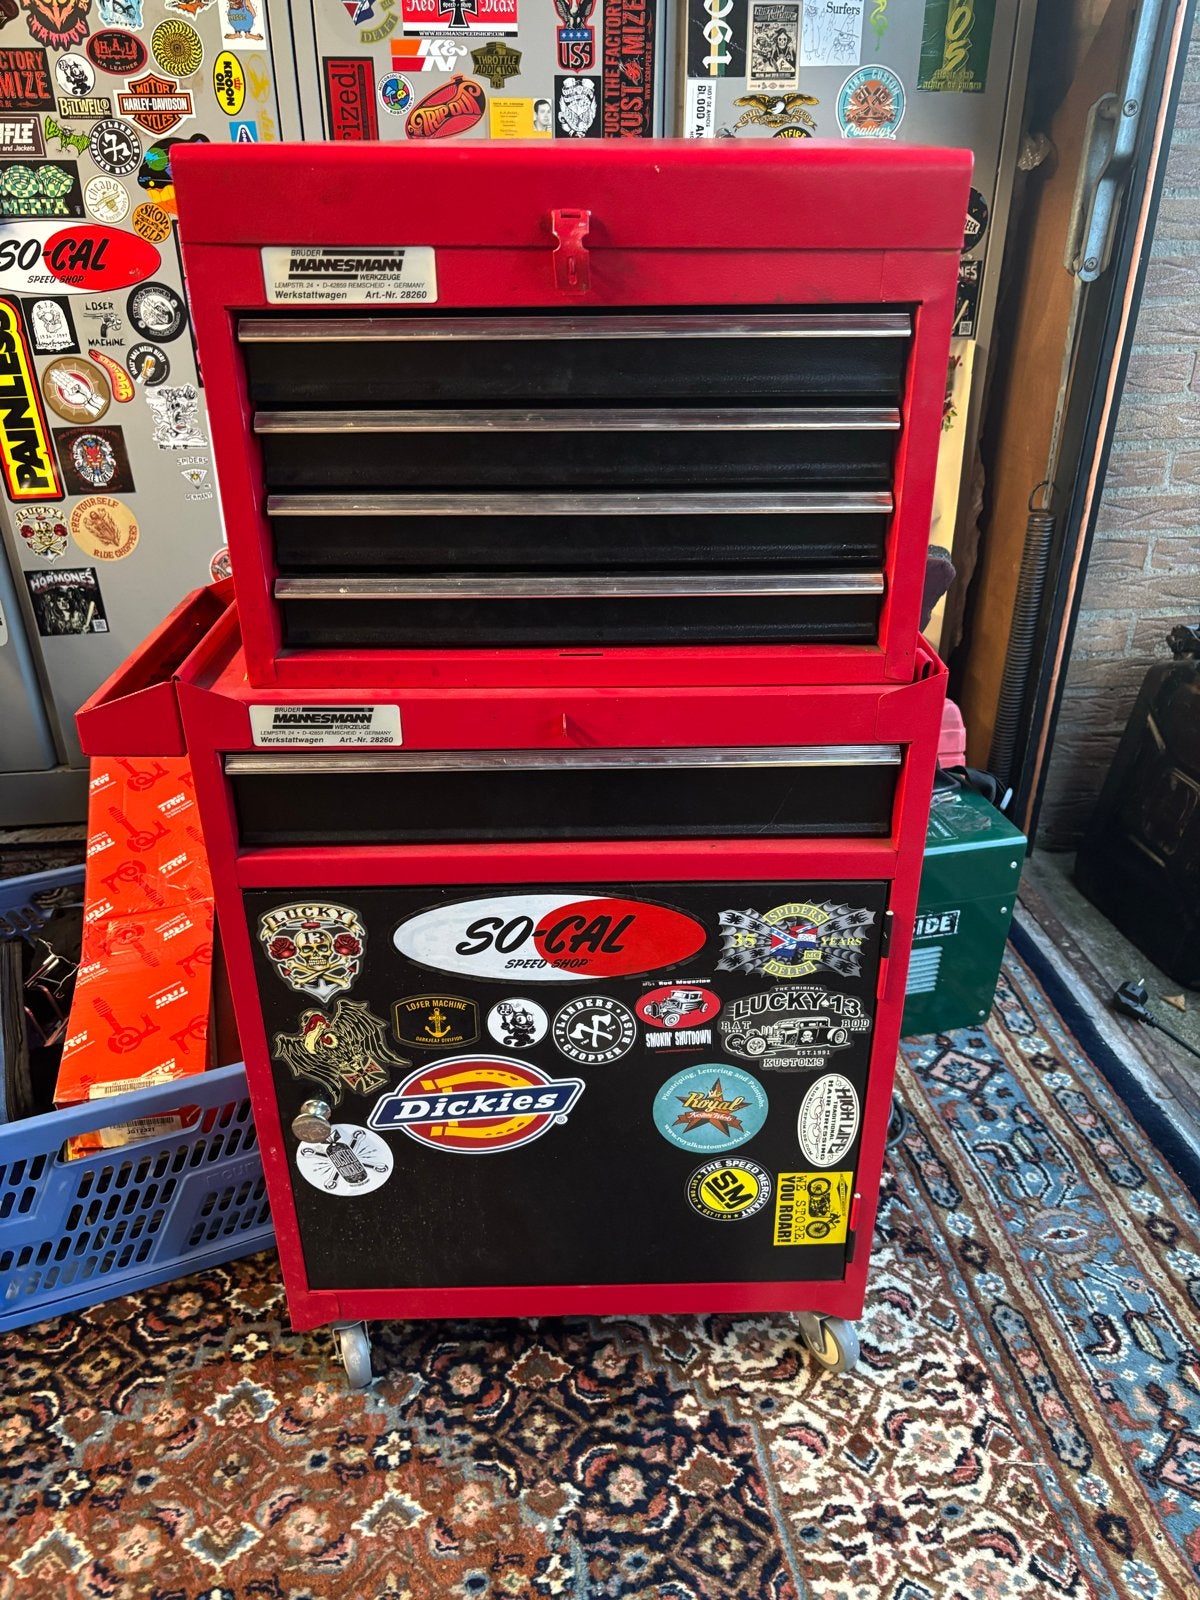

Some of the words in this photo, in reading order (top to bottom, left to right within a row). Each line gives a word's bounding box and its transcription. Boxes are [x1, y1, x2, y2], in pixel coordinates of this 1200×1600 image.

[827, 2, 860, 15] Surfers
[477, 55, 516, 65] THROTTLE
[560, 42, 593, 68] USA
[109, 62, 138, 71] LEATHER
[474, 65, 519, 74] ADDICTION
[136, 79, 170, 94] MOTOR
[216, 73, 225, 93] OIL
[223, 61, 235, 106] KROON
[604, 68, 620, 97] THE
[846, 75, 864, 94] KING
[872, 71, 900, 95] CUSTOM
[123, 97, 188, 111] HARLEY-DAVIDSON
[140, 114, 173, 129] CYCLES
[140, 204, 169, 230] SHOW
[134, 218, 166, 242] FIELD
[0, 238, 110, 272] SO-CAL
[289, 259, 403, 272] MANNESMANN
[27, 275, 57, 284] SPEED
[59, 275, 84, 284] SHOP
[275, 291, 347, 300] Werkstattwagen
[365, 291, 398, 299] Art.-Nr.
[400, 291, 427, 299] 28260
[85, 302, 114, 311] LOSER
[88, 338, 126, 347] MACHINE
[19, 507, 58, 518] LUCKY
[76, 497, 119, 515] YOURSELF
[72, 512, 81, 533] FREE
[93, 548, 114, 560] RIDE
[115, 525, 138, 558] CHOPPERS
[30, 570, 95, 591] HORMONES
[273, 714, 373, 724] MANNESMANN
[157, 792, 186, 812] TRW
[158, 852, 187, 873] TRW
[271, 906, 349, 925] LUCKY
[768, 905, 825, 925] SPIDERS
[163, 920, 193, 941] TRW
[455, 914, 637, 956] SO-CAL
[913, 916, 951, 935] IDE
[304, 932, 324, 944] 13
[732, 933, 756, 948] 35
[821, 936, 863, 947] YEARS
[505, 959, 547, 969] SPEED
[551, 959, 589, 969] SHOP
[771, 962, 813, 977] DELFT
[155, 987, 188, 1009] TRW
[406, 1000, 430, 1012] LOSER
[432, 1000, 468, 1011] MACHINE
[734, 992, 824, 1020] LUCKY
[831, 994, 861, 1018] 13
[555, 999, 613, 1036] FLANDERS
[620, 1014, 633, 1044] BASH
[720, 1021, 752, 1030] RAT
[841, 1019, 870, 1028] ROD
[63, 1031, 88, 1051] RW
[675, 1029, 712, 1046] SHUTDOWN
[563, 1043, 622, 1062] CHOPPER
[763, 1058, 824, 1067] KUSTOMS
[698, 1068, 732, 1076] Lettering
[735, 1072, 747, 1082] and
[394, 1092, 559, 1120] Dickies
[684, 1092, 744, 1112] Royal
[835, 1088, 854, 1121] HIGH
[829, 1101, 838, 1141] TRADITIONAL
[820, 1110, 830, 1160] DRESSING
[827, 1125, 853, 1154] LIFE
[700, 1161, 722, 1174] THE
[725, 1160, 759, 1174] SPEED
[780, 1176, 795, 1201] YOU
[797, 1175, 807, 1191] WE
[741, 1173, 771, 1217] MERCHANT
[777, 1205, 794, 1243] ROAR!
[794, 1200, 806, 1243] STORE,
